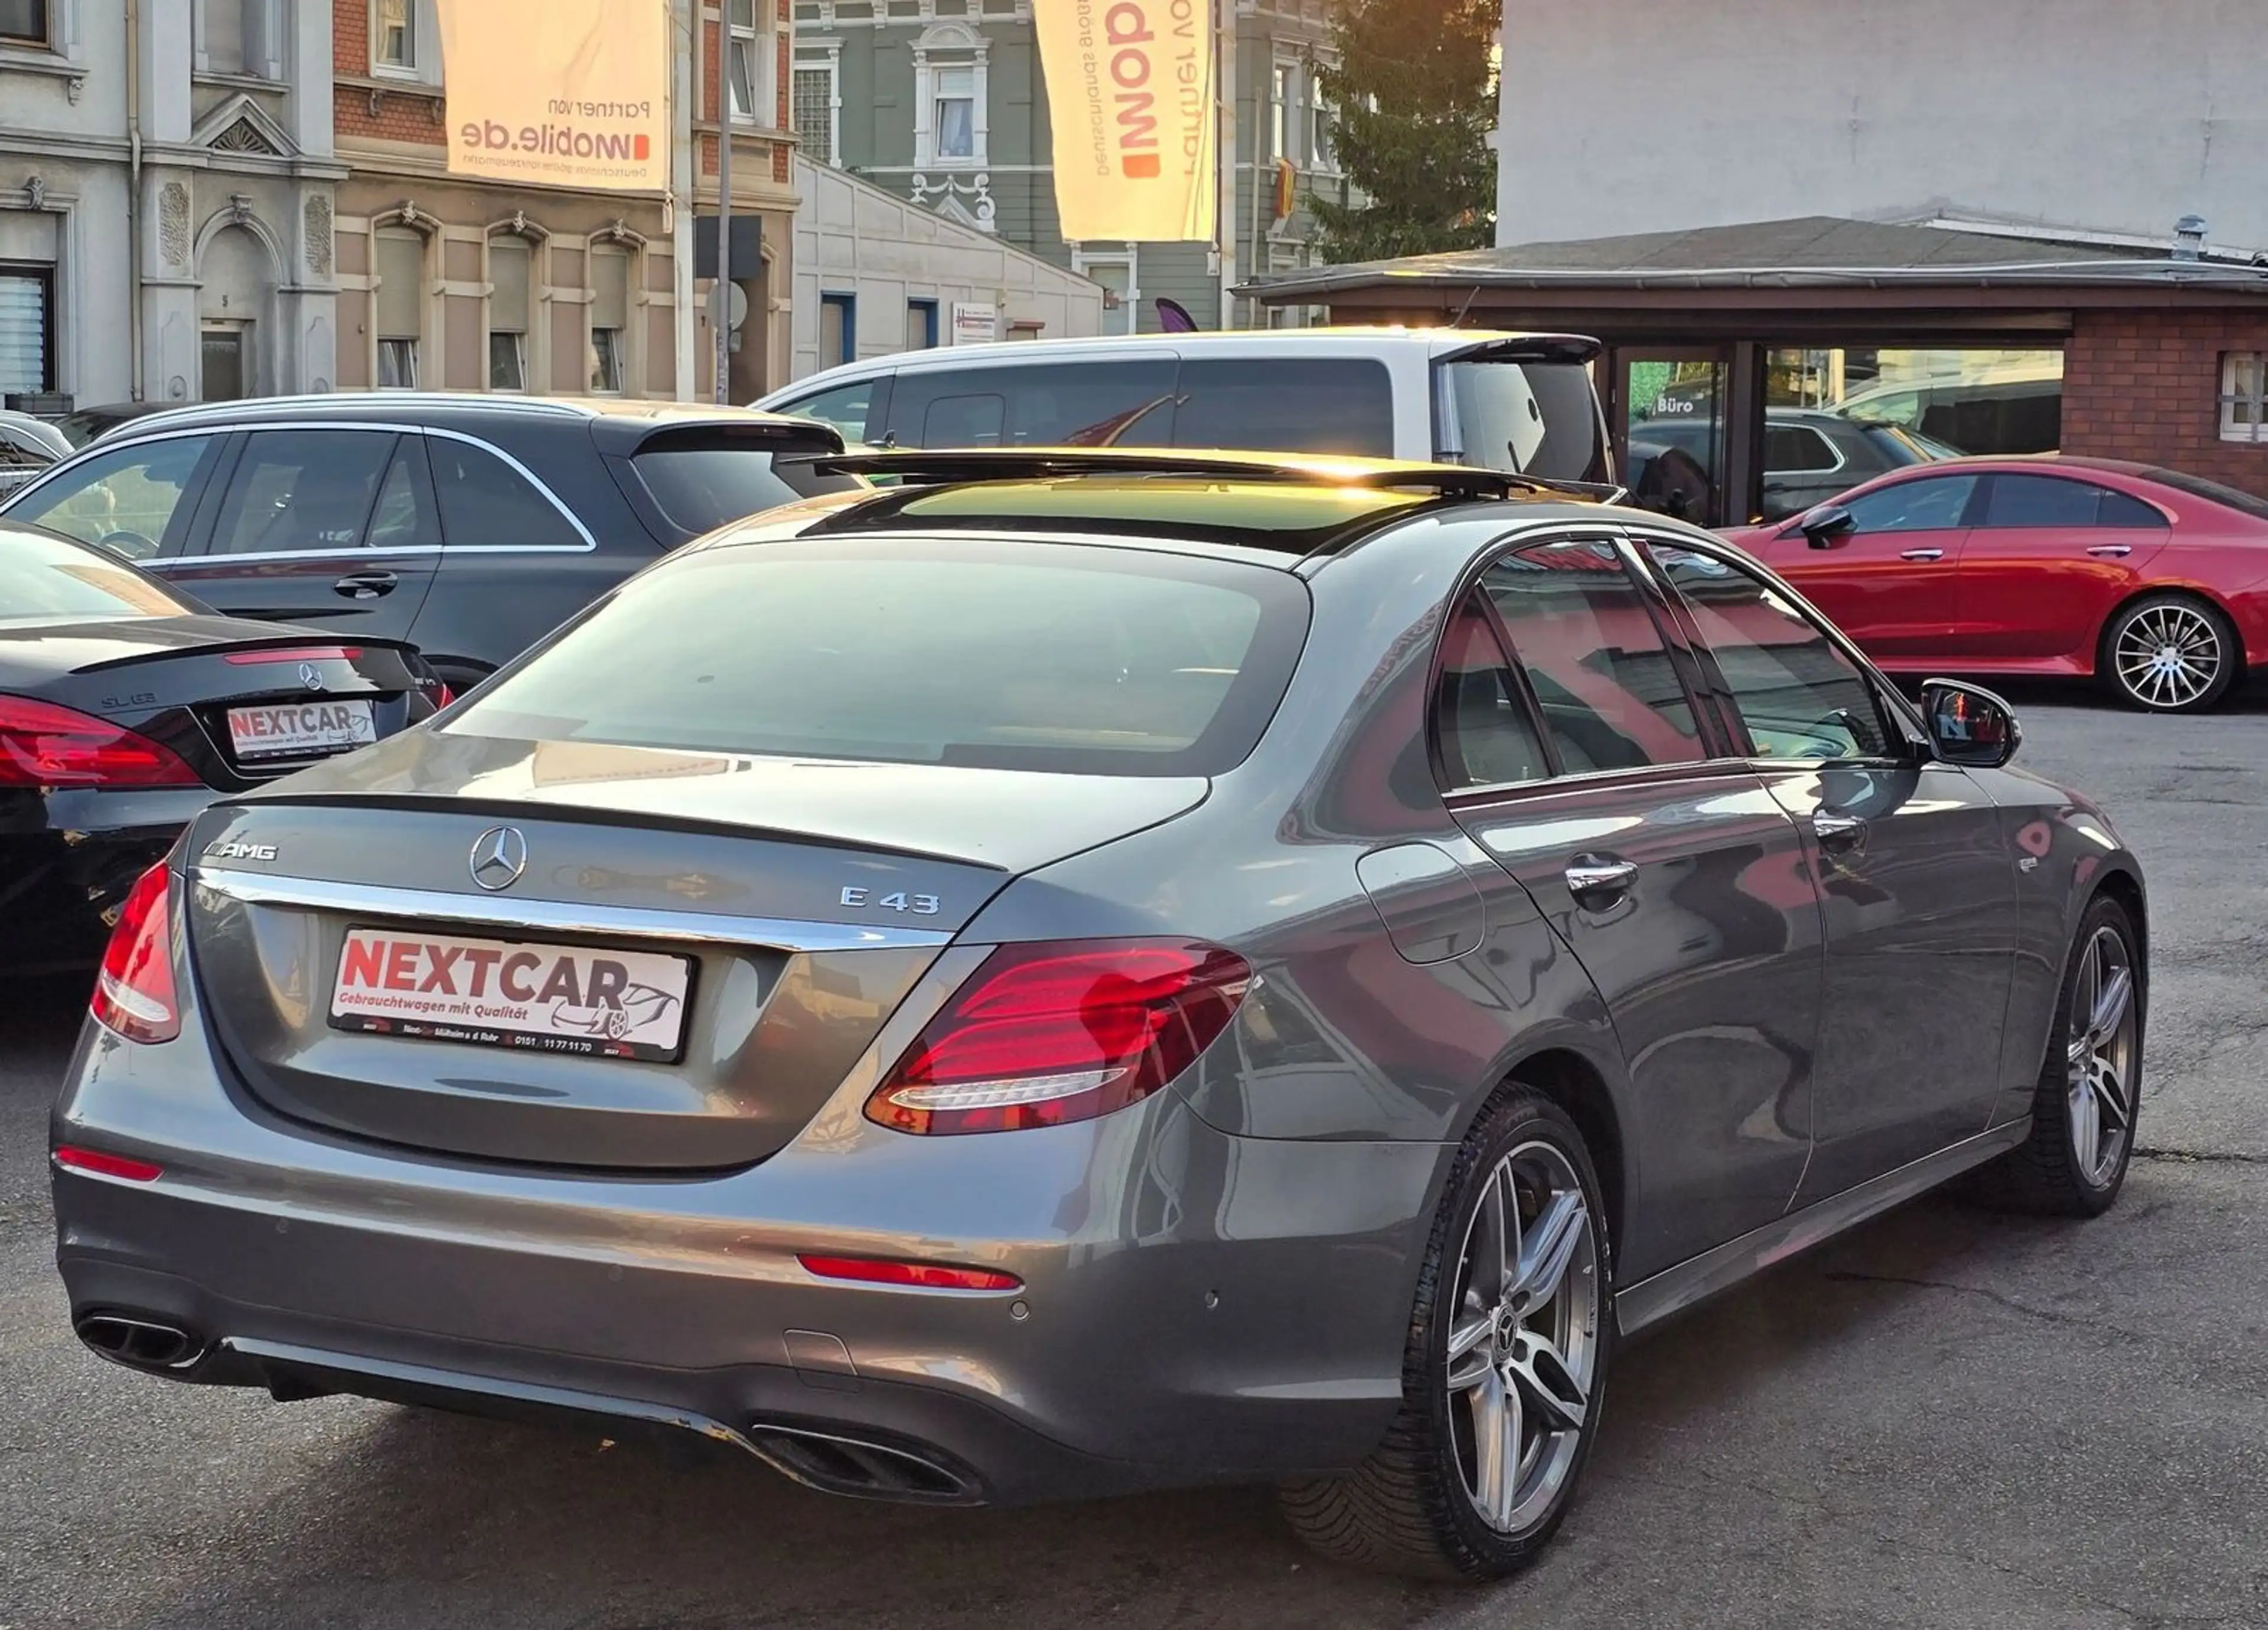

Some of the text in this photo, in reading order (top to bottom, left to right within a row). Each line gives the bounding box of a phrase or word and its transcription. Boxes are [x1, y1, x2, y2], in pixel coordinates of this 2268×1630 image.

[1657, 397, 1693, 413] Büro
[230, 706, 352, 738] NEXTCAR
[220, 843, 278, 860] AMG
[840, 886, 940, 914] E 43
[342, 938, 628, 1010] NEXTCAR
[339, 992, 528, 1021] Gebrauchtwagen mit Qualität
[514, 1036, 536, 1045] 0151
